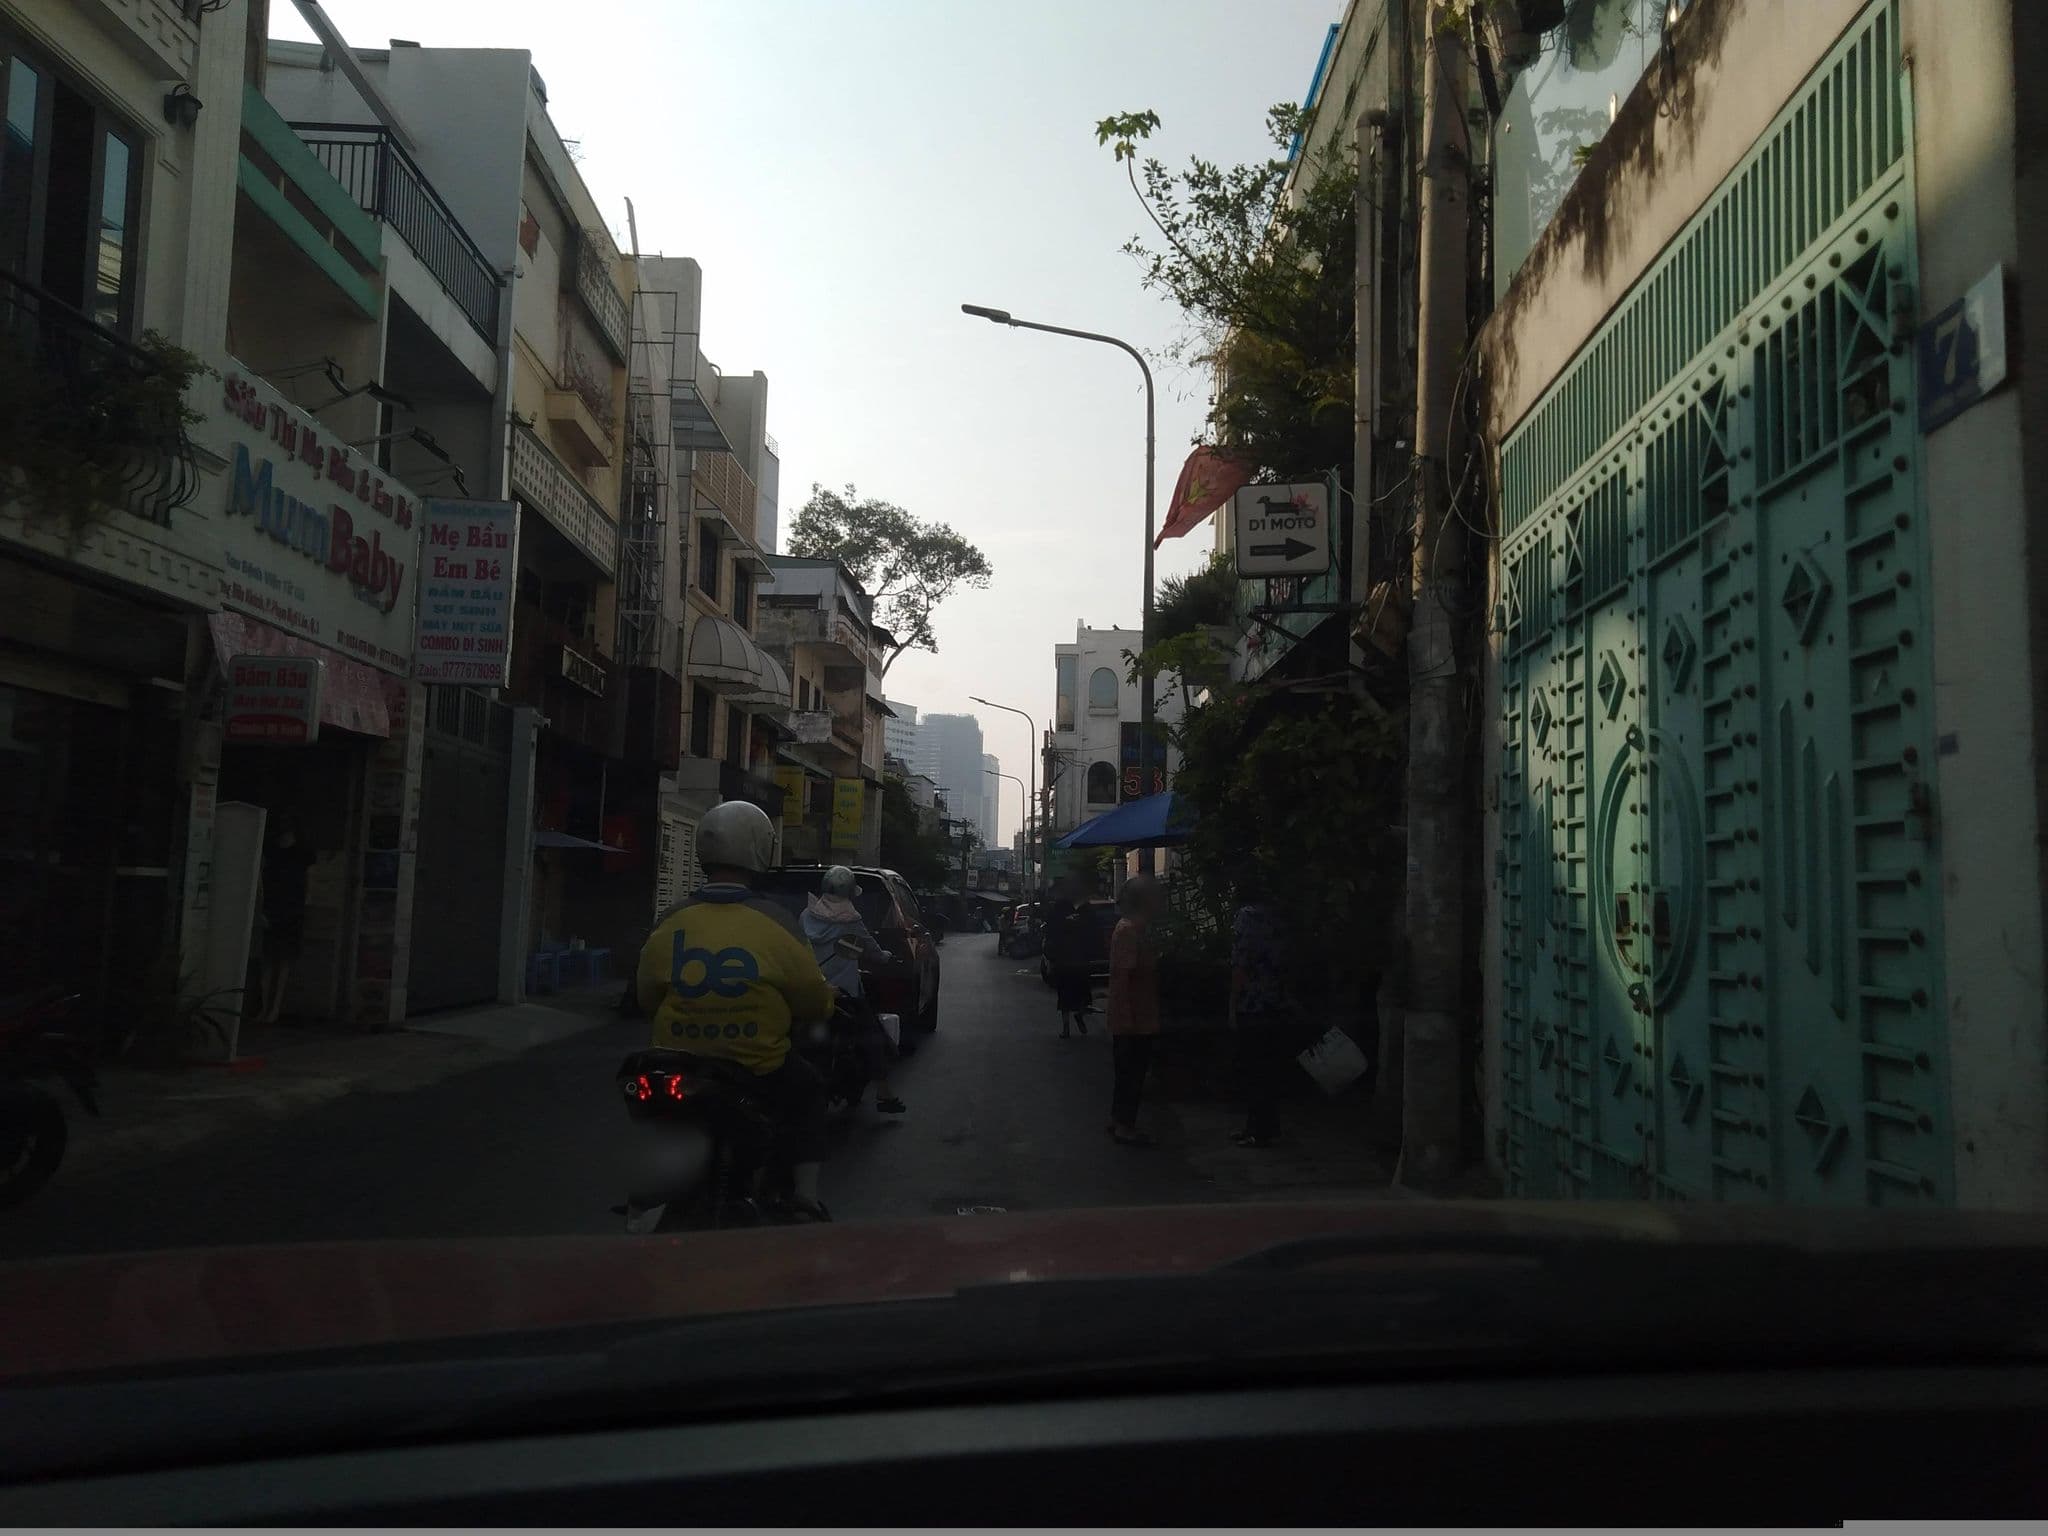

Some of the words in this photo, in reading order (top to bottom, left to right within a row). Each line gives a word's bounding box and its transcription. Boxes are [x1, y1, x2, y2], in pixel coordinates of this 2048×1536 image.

[430, 522, 460, 551] Mẹ
[466, 521, 508, 549] Bầu
[1249, 519, 1266, 531] D1
[1271, 517, 1316, 530] MOTO
[433, 556, 468, 579] Em
[474, 560, 501, 581] Bé
[671, 929, 759, 998] be
